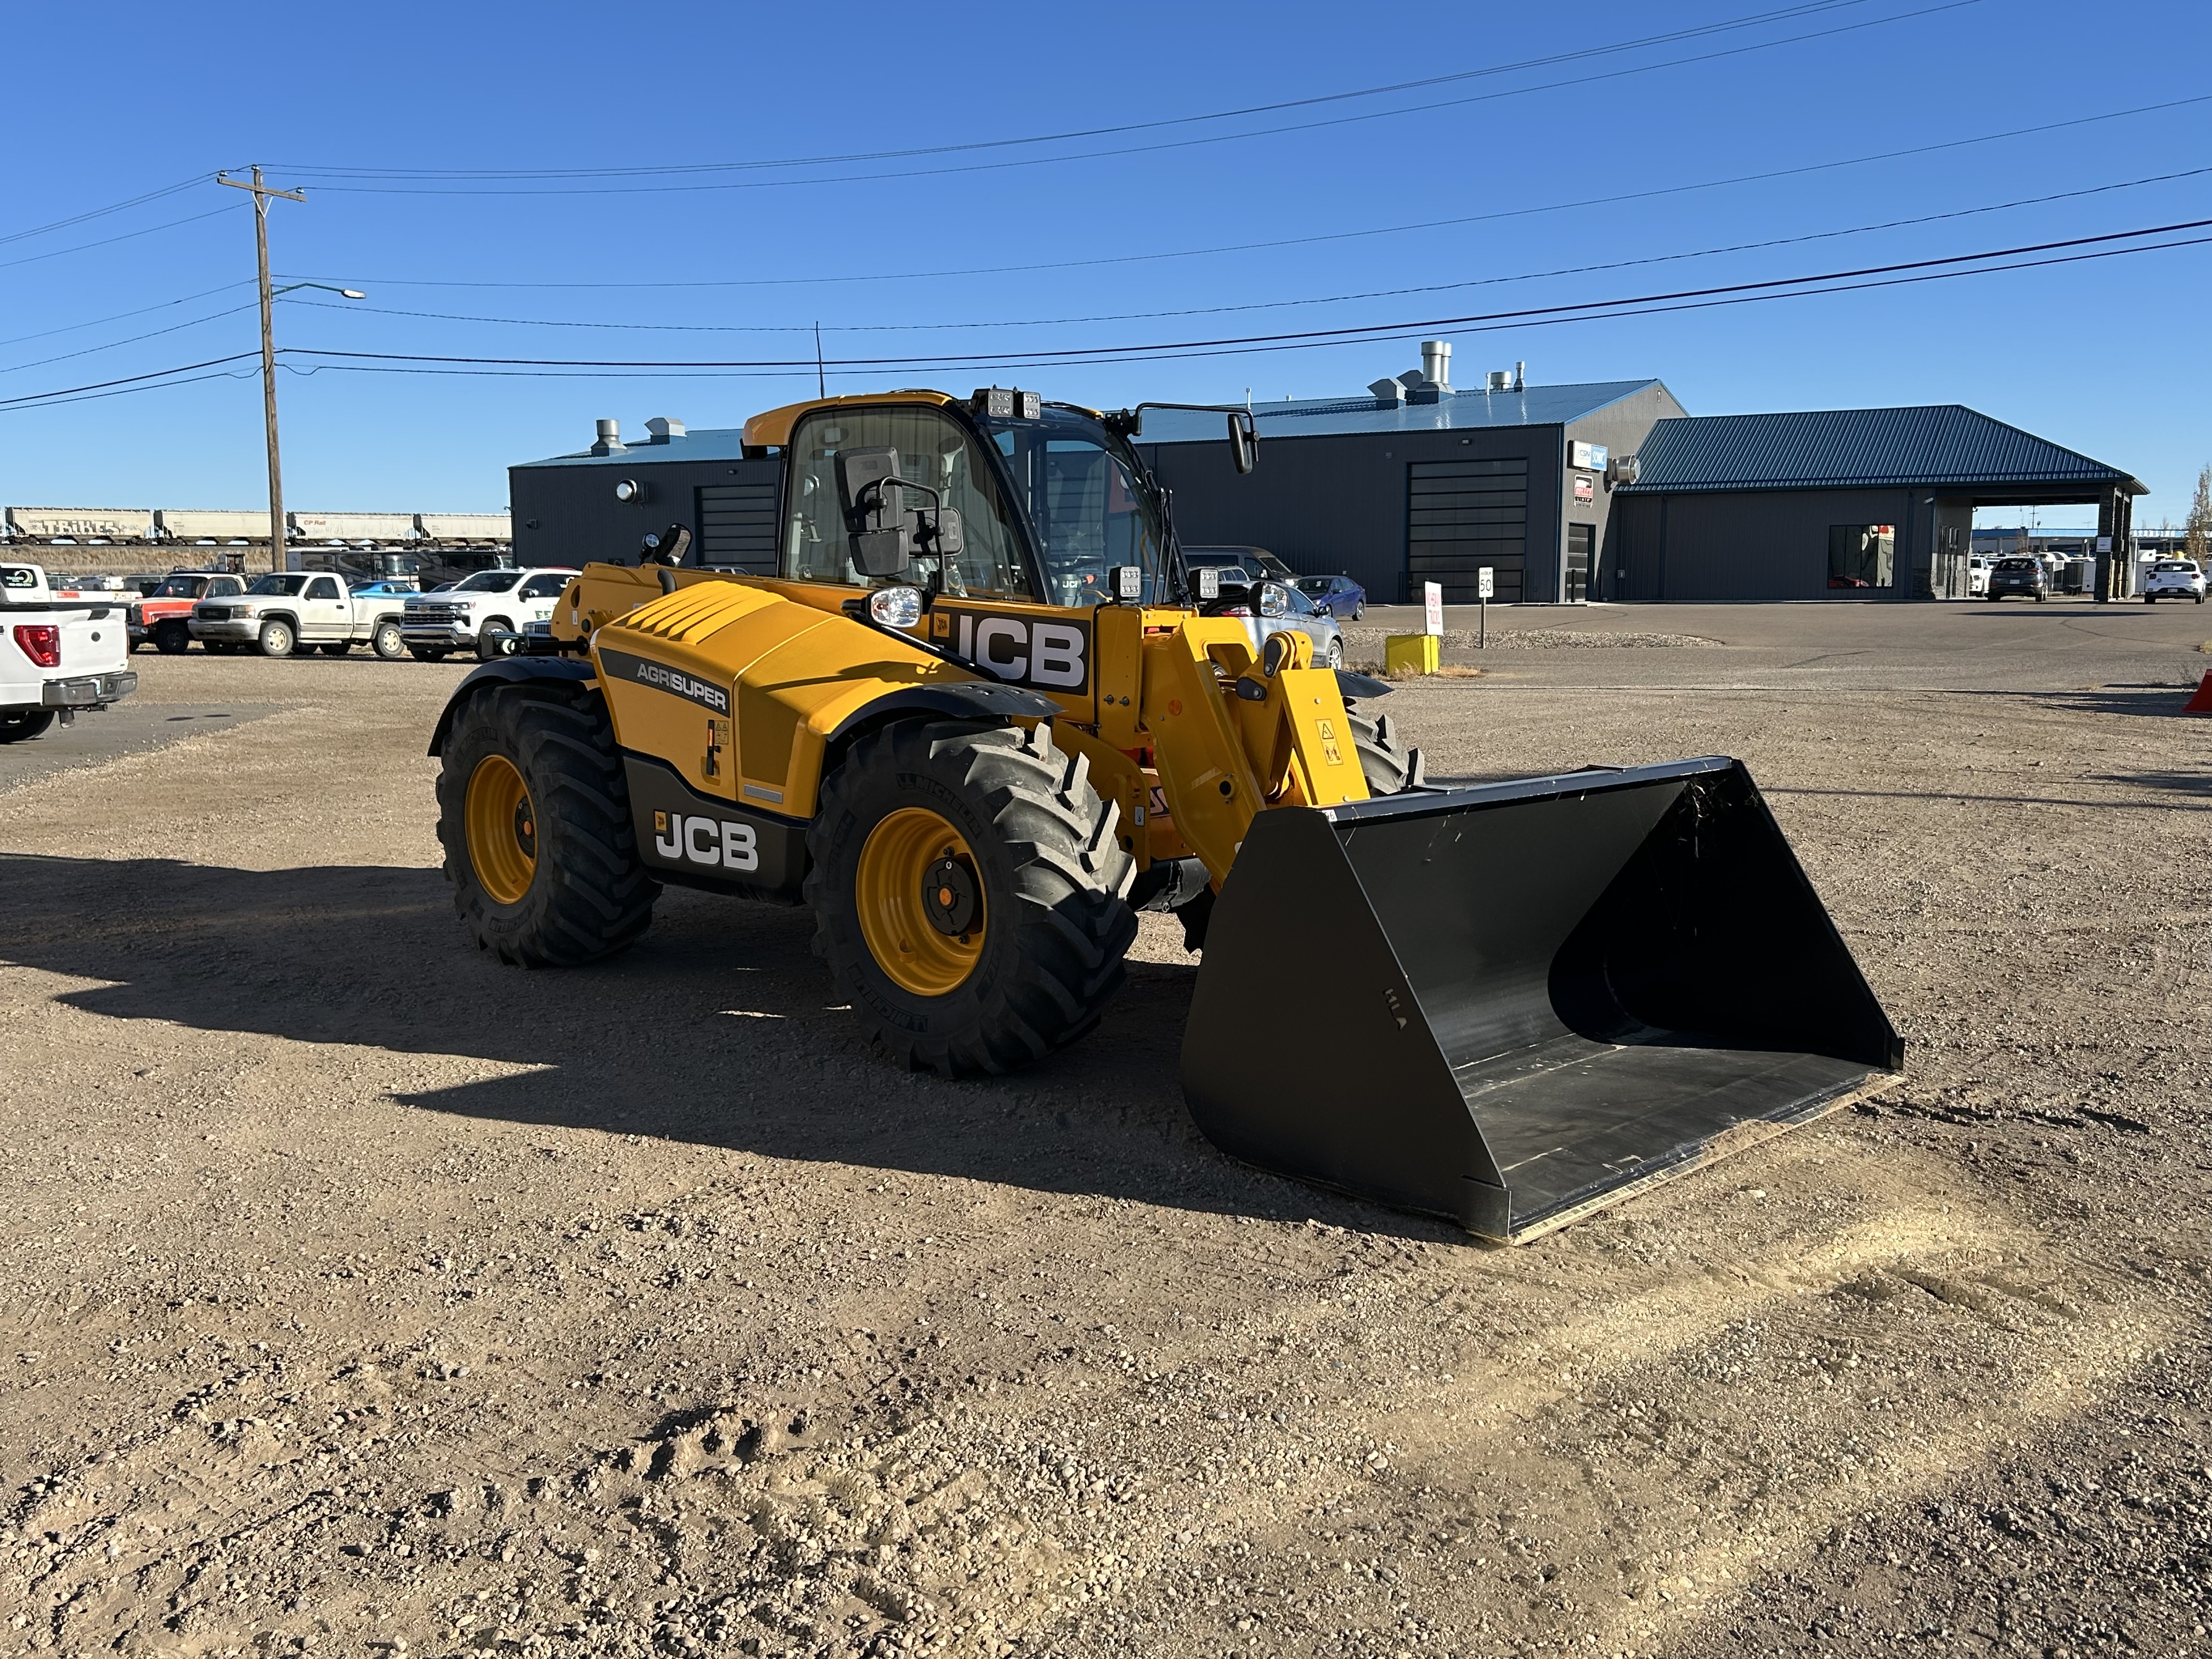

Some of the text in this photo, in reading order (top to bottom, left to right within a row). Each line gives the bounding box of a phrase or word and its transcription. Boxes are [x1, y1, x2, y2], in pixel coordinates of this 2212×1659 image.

[1480, 579, 1492, 591] 50
[934, 615, 1085, 687] JCB
[637, 663, 726, 710] AGRISUPER
[915, 775, 983, 838] MICHELIN
[656, 814, 758, 871] JCB
